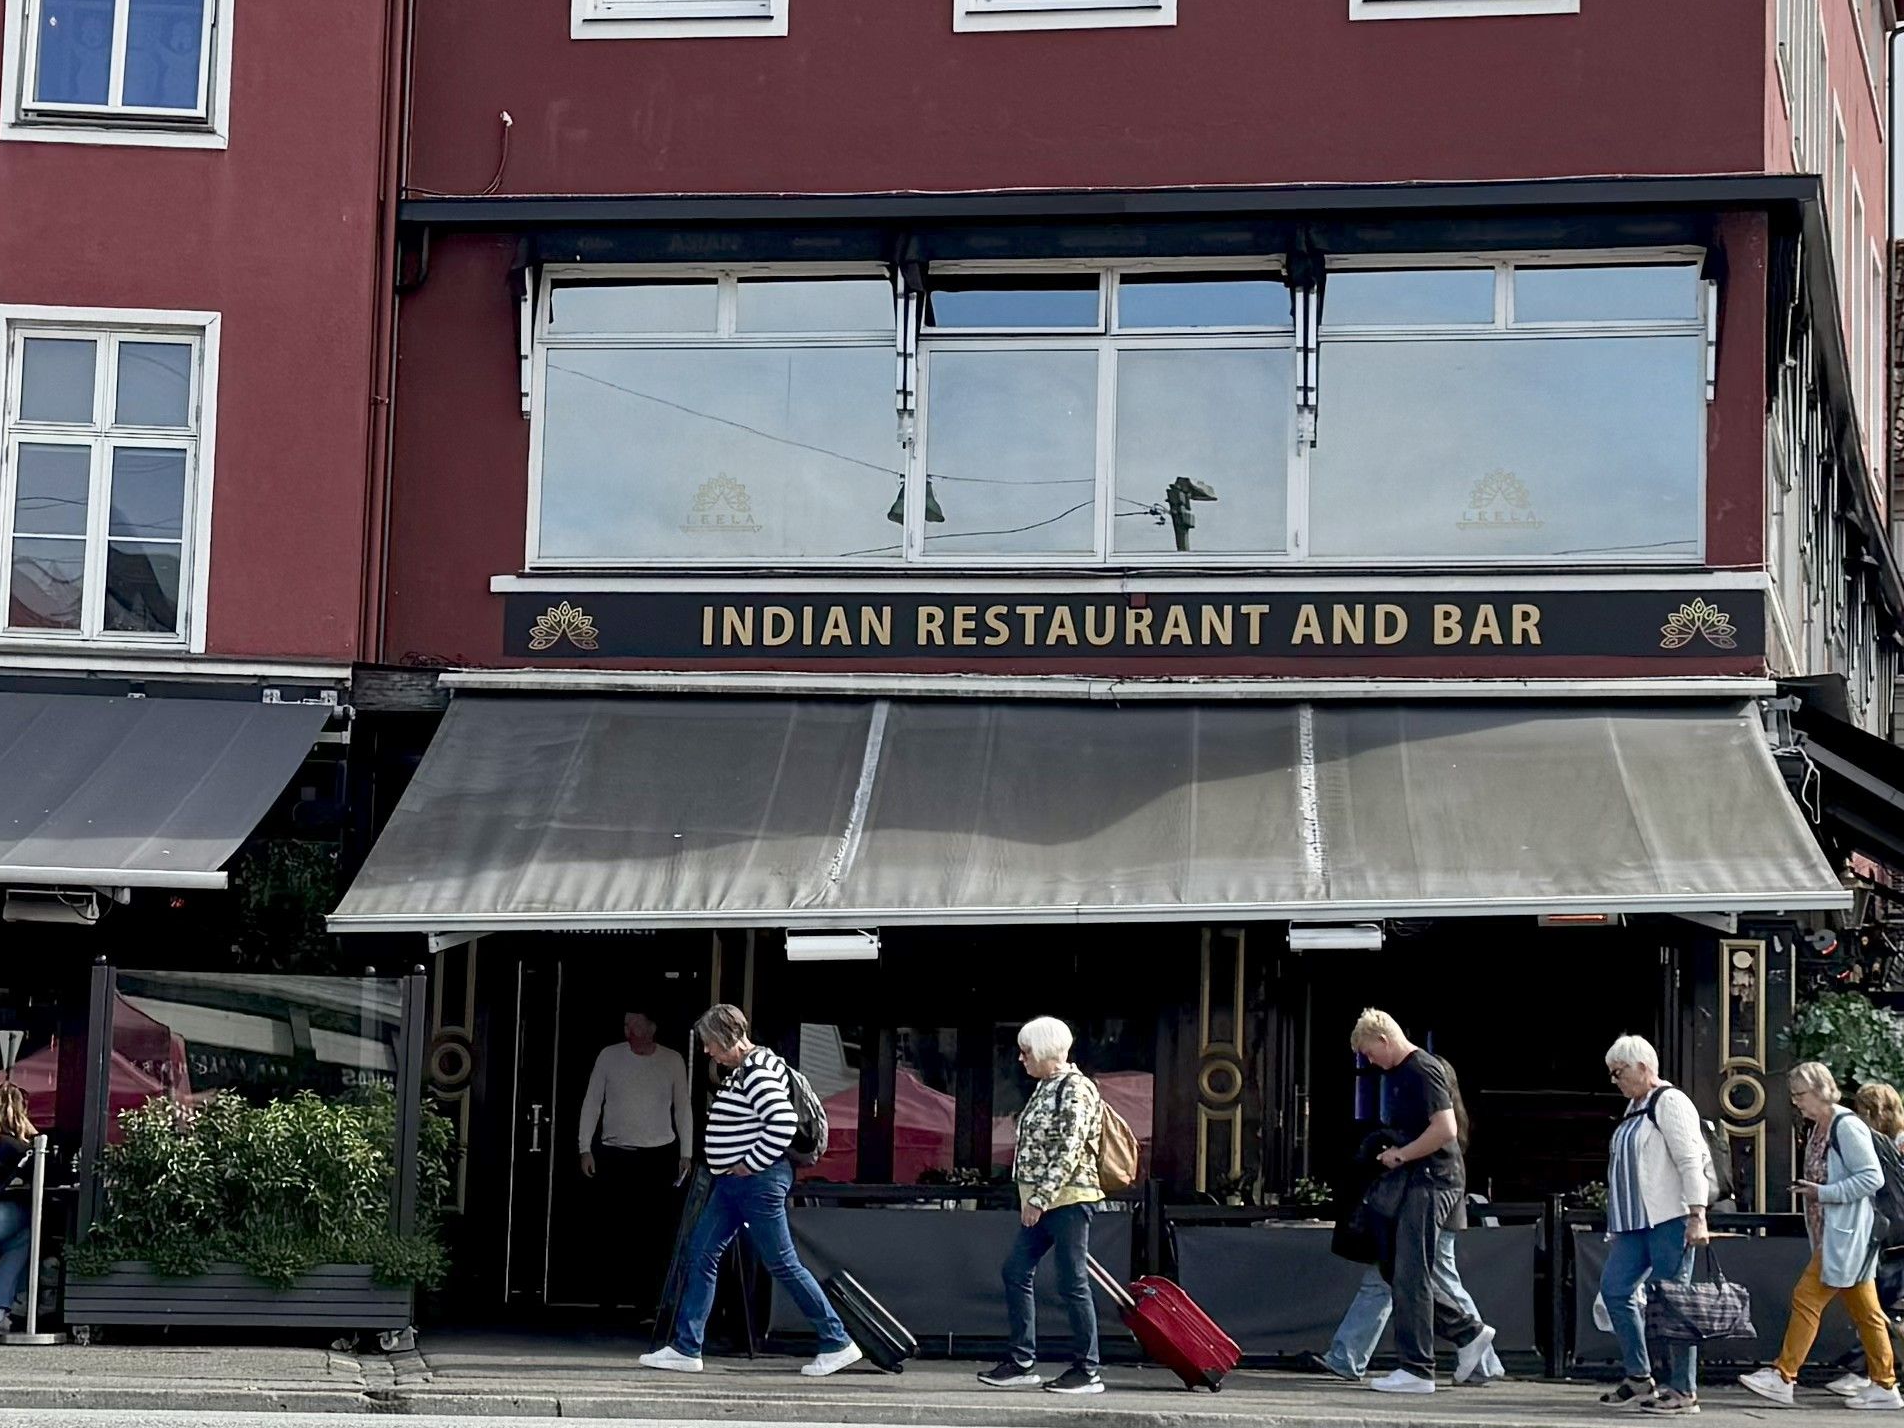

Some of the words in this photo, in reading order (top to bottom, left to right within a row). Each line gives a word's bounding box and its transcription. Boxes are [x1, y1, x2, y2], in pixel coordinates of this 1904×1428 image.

[687, 514, 755, 525] LEELA
[1463, 510, 1536, 523] LEELA
[702, 605, 892, 646] INDIAN
[916, 604, 1270, 646] RESTAURANT
[1291, 603, 1409, 645] AND
[1432, 603, 1542, 645] BAR
